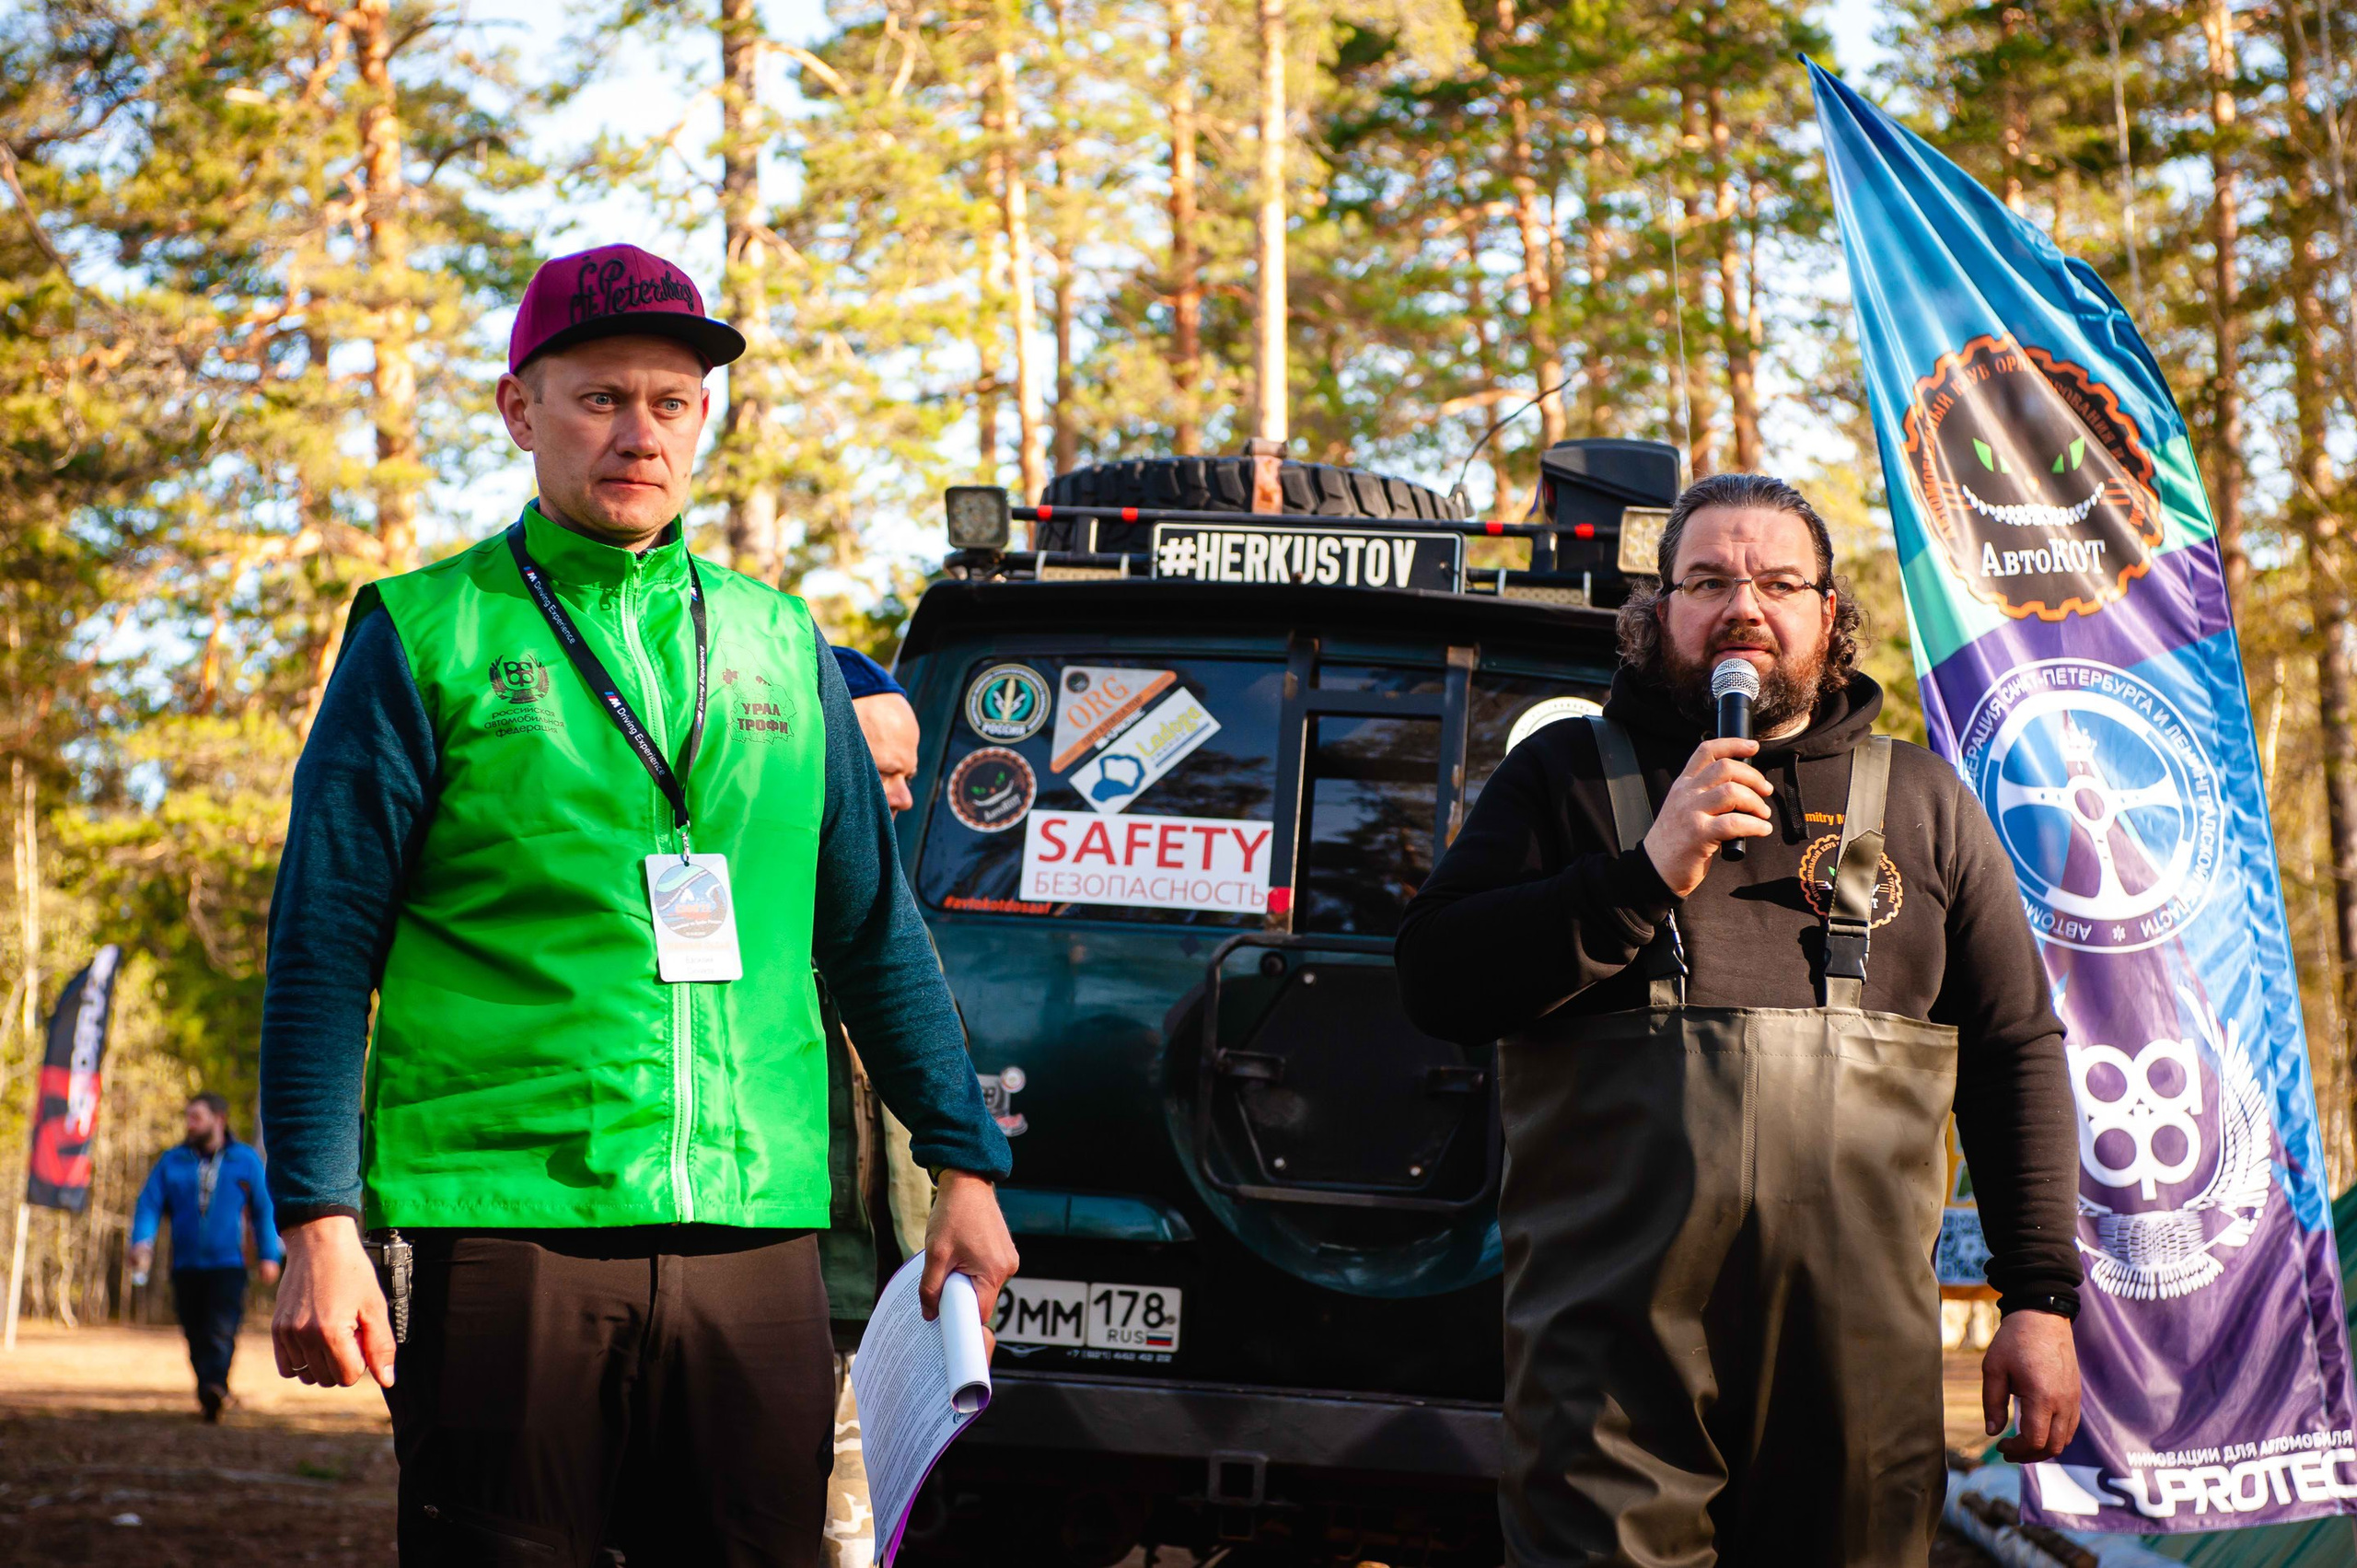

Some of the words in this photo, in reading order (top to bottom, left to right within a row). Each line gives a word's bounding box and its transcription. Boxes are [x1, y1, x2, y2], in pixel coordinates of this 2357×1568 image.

[1950, 363, 1991, 397] КУБ
[1158, 532, 1417, 588] #HERKUSTOV
[534, 581, 551, 608] Driving
[548, 604, 575, 644] Experience
[492, 705, 555, 719] российская
[741, 703, 781, 716] УРАЛ
[1066, 675, 1130, 729] ORG
[2002, 667, 2152, 715] САНКТ-ПЕТЕРБУРГА
[2153, 710, 2170, 727] И
[484, 714, 565, 729] автомобильная
[495, 724, 558, 738] федерация
[737, 717, 788, 734] ТРОФИ
[1135, 705, 1202, 757] Ladoga
[617, 708, 637, 735] Driving
[634, 733, 665, 775] Experience
[1805, 811, 1834, 826] mitry
[1037, 819, 1272, 873] SAFETY
[1035, 871, 1267, 907] БЕЗОПАСНОСТЬ
[1093, 1290, 1165, 1329] 178
[1107, 1329, 1144, 1344] RUS
[2126, 1446, 2221, 1468] ИННОВАЦИИ
[2223, 1442, 2258, 1463] ДЛЯ
[2260, 1429, 2352, 1457] АВТОМОБИЛЯ
